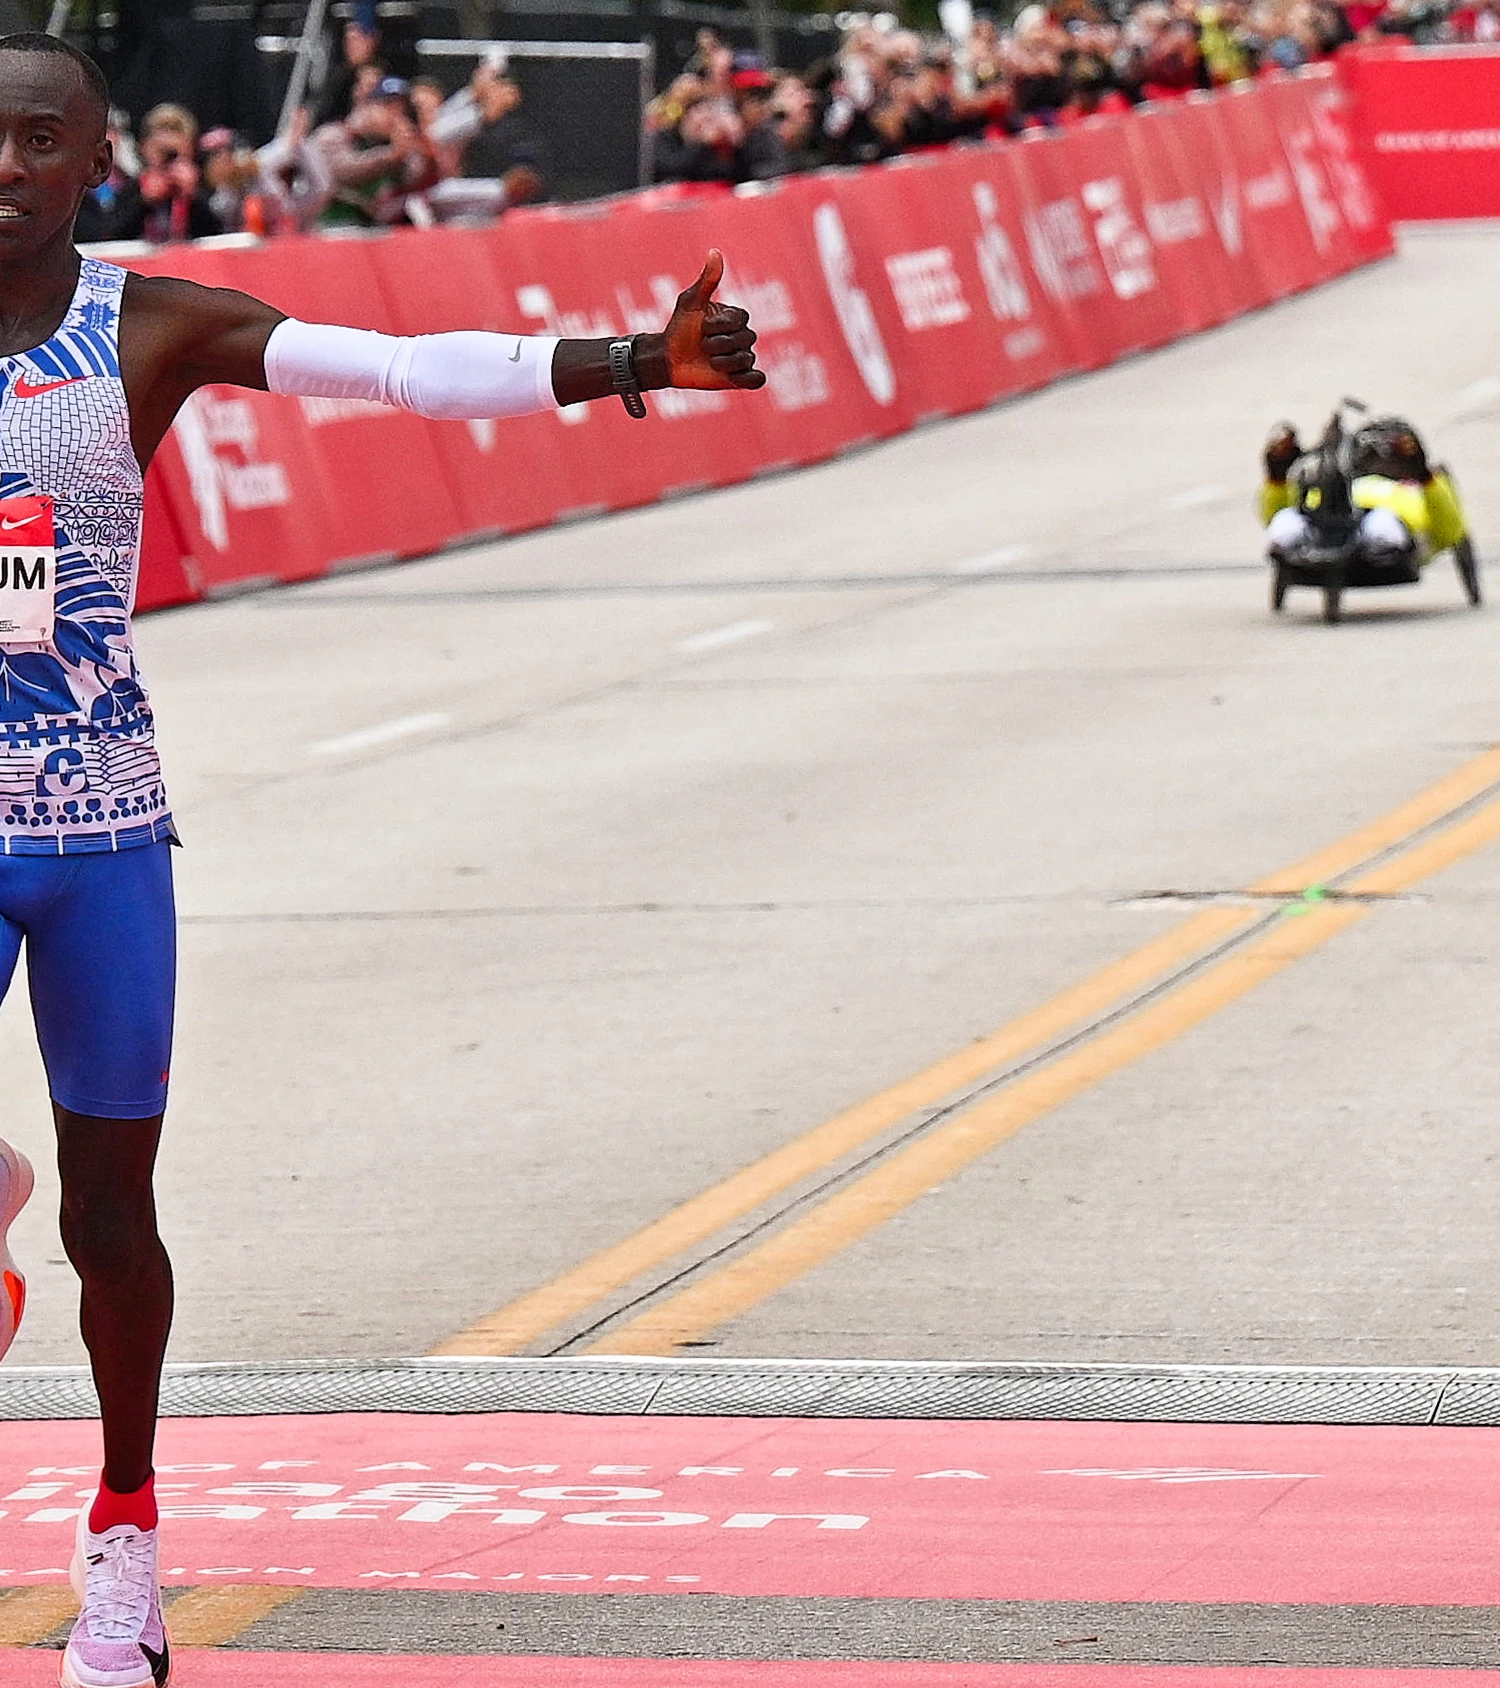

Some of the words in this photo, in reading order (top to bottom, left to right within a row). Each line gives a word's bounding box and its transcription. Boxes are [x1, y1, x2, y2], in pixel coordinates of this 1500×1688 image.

[153, 1461, 320, 1474] OF
[356, 1461, 991, 1480] AMERICA
[358, 1570, 701, 1583] MAJORS
